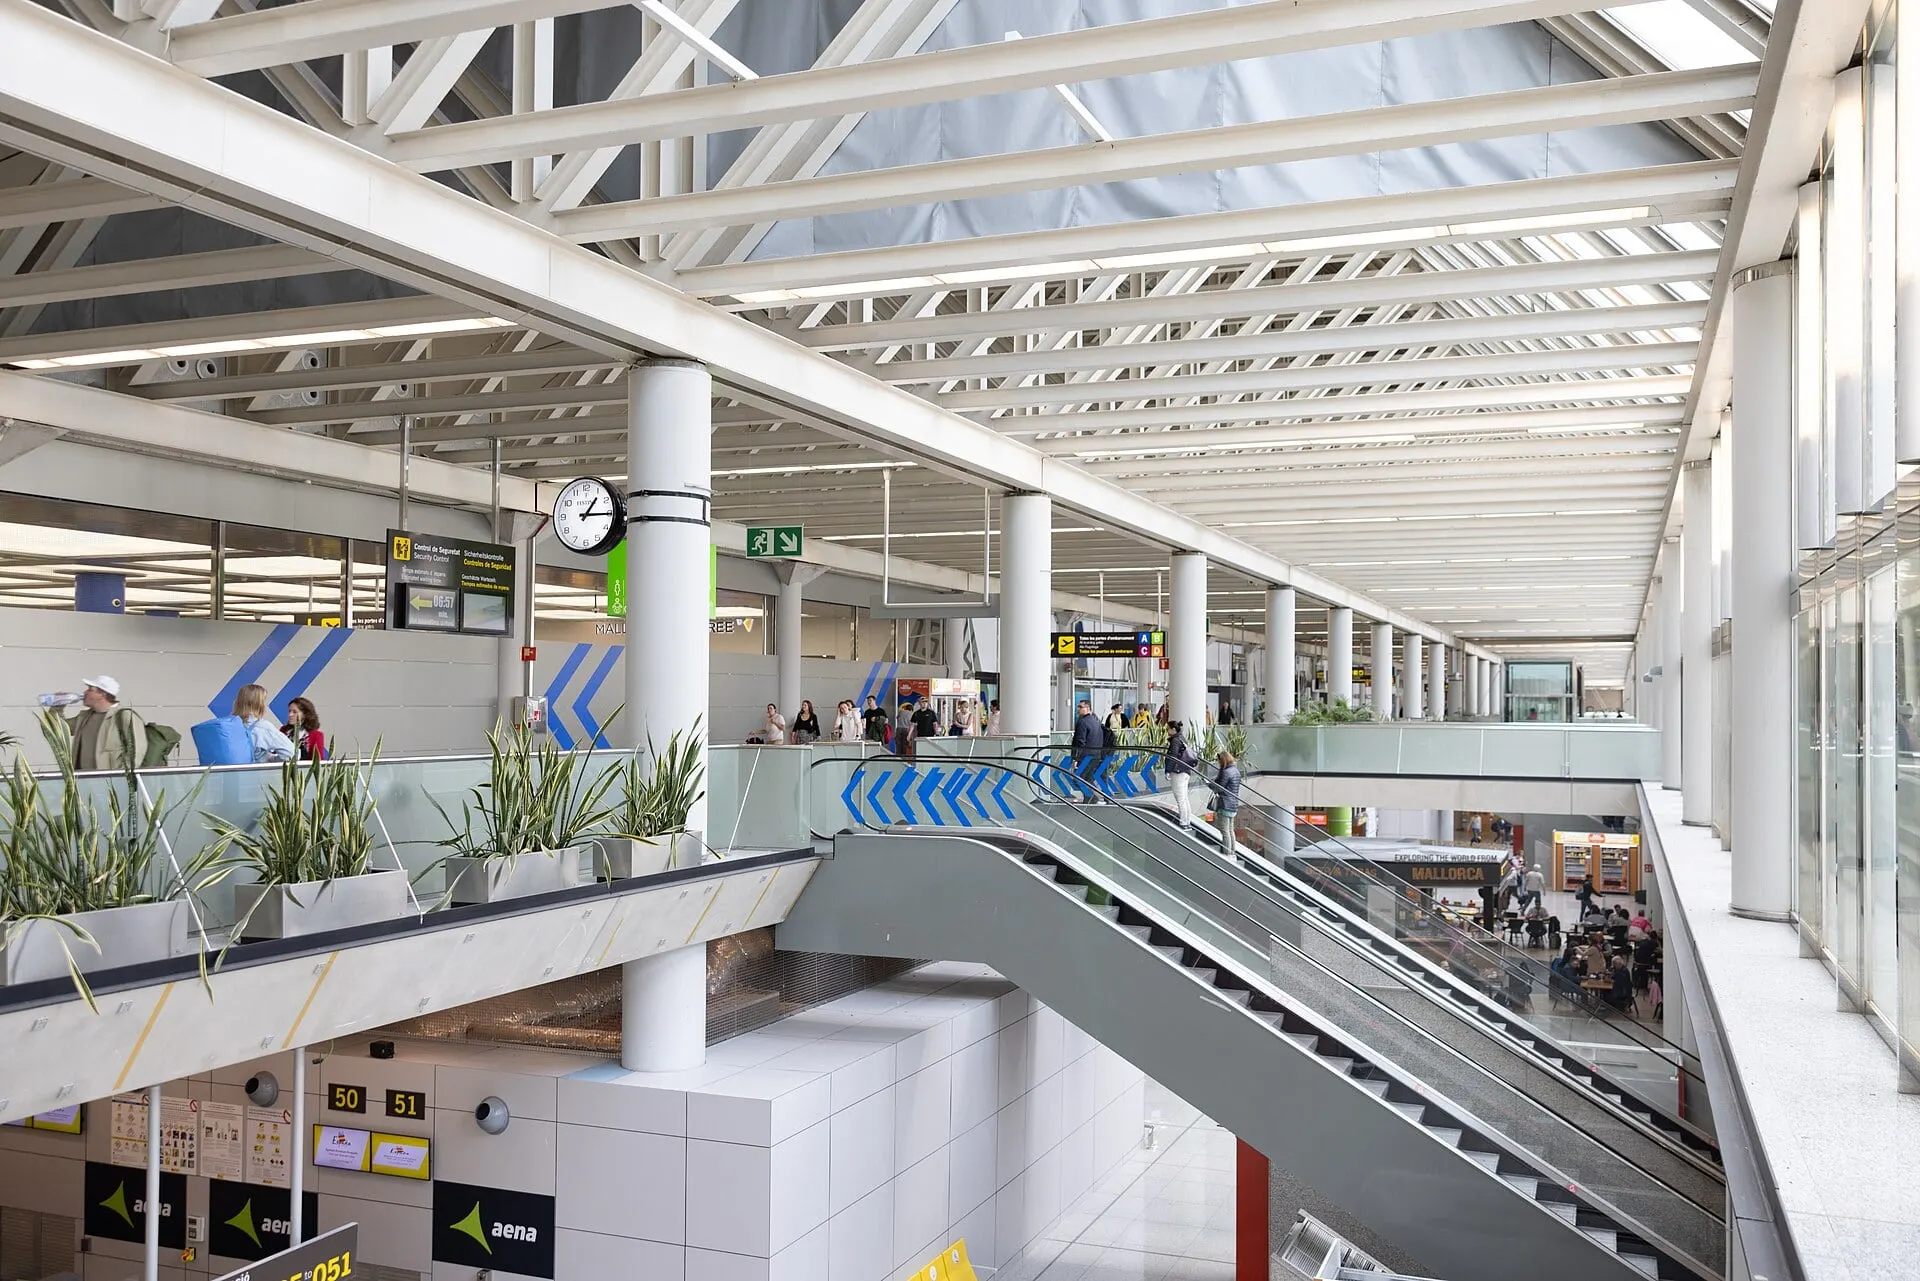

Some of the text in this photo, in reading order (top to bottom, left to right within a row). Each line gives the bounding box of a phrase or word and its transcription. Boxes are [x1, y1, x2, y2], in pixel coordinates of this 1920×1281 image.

[582, 484, 591, 492] 12
[573, 489, 579, 497] 11
[564, 499, 573, 507] 10
[603, 496, 610, 504] 2
[560, 513, 567, 521] 9
[563, 526, 570, 534] 8
[572, 535, 578, 543] 7
[594, 534, 600, 542] 5
[414, 543, 431, 552] Control
[582, 539, 590, 547] 6
[413, 552, 449, 563] Security Control
[463, 550, 504, 561] Sicherheitskontrolle
[463, 559, 484, 568] Controles
[491, 561, 512, 571] Seguridad
[433, 595, 454, 609] 06:57
[595, 623, 627, 635] MALL
[709, 621, 734, 633] REE
[1141, 634, 1148, 643] A
[1154, 634, 1160, 643] B
[1141, 646, 1148, 655] C
[1154, 647, 1161, 655] D
[1394, 853, 1498, 862] EXPLORING THE WORLD FROM
[1411, 867, 1485, 881] MALLORCA
[335, 1087, 358, 1109] 50
[394, 1093, 417, 1116] 51
[133, 1199, 172, 1217] aa
[261, 1217, 291, 1235] aen
[491, 1222, 537, 1242] aena
[304, 1271, 313, 1280] to
[312, 1251, 352, 1281] 051
